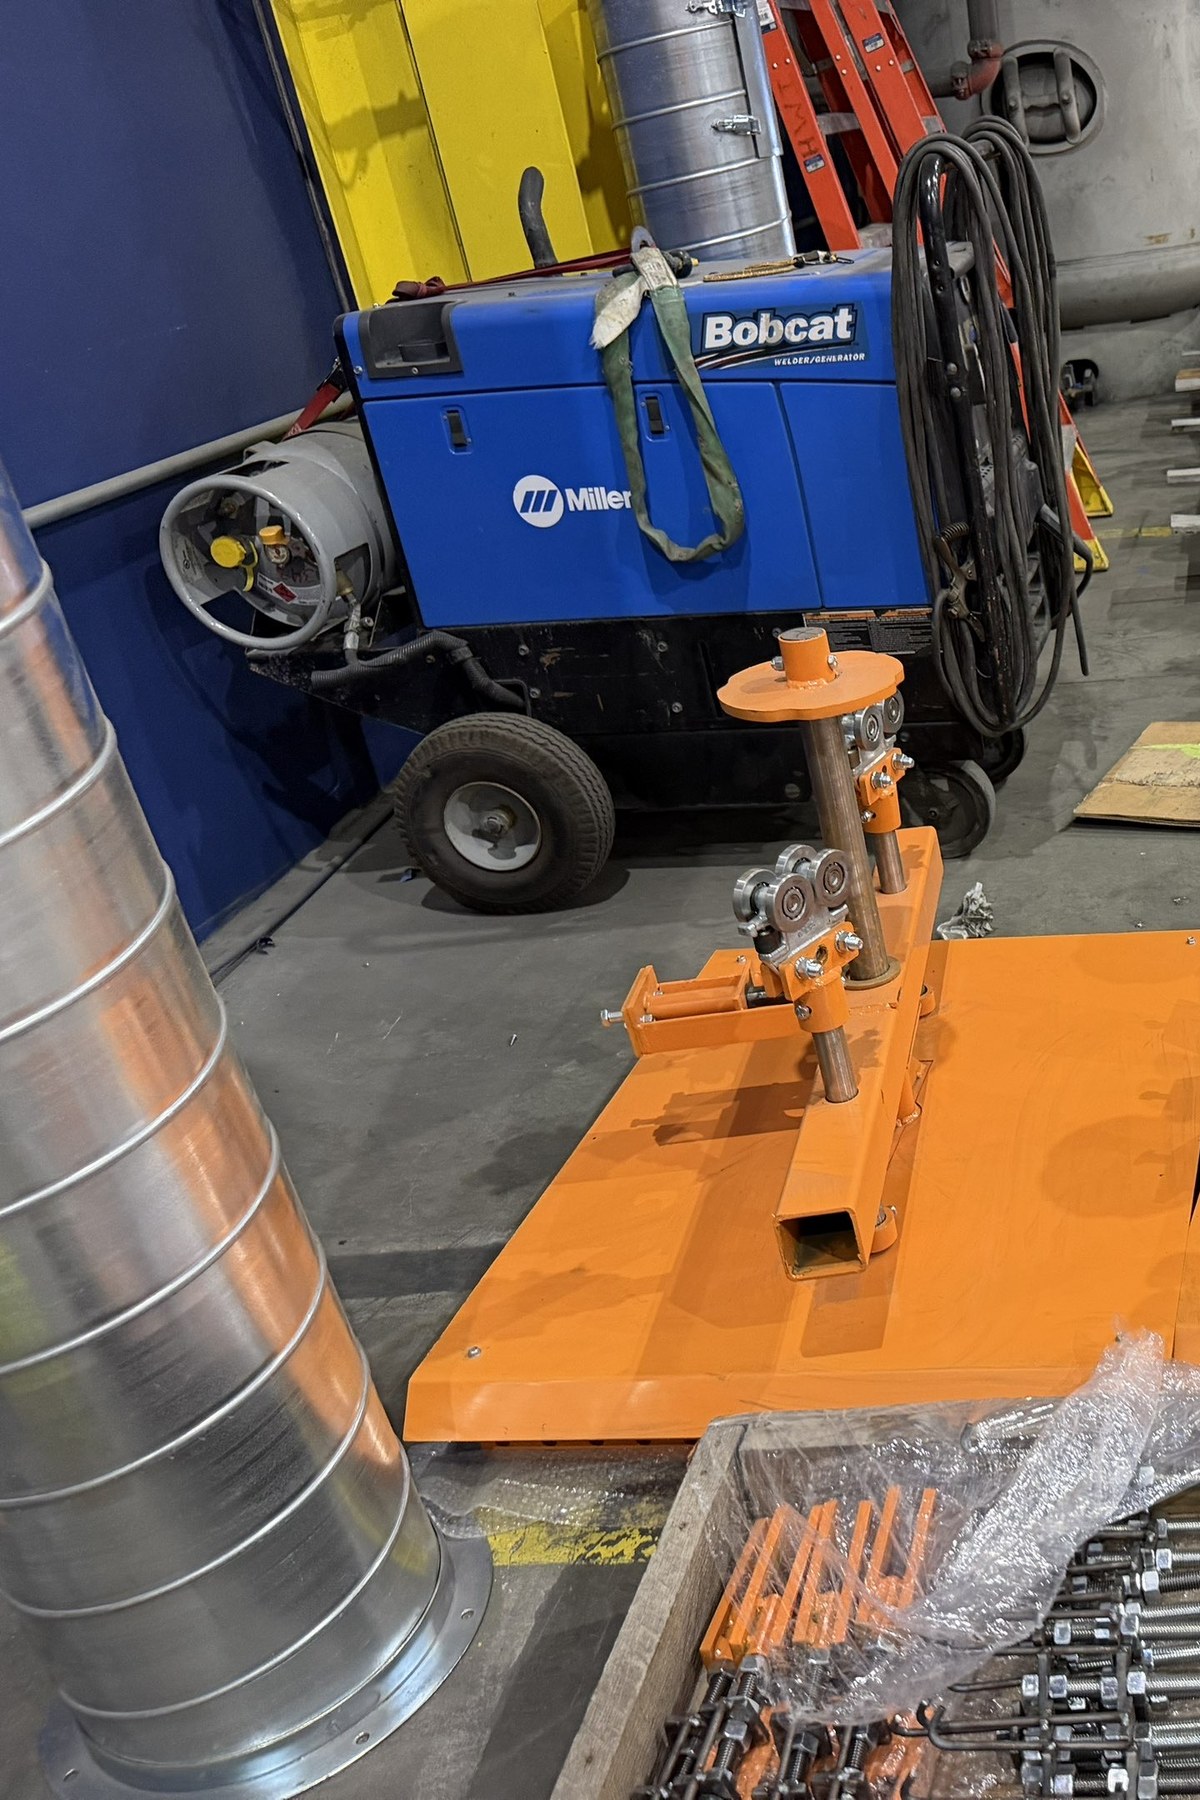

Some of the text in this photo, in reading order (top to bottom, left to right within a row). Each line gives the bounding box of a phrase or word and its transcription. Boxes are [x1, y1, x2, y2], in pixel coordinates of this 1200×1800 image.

[703, 306, 854, 349] Bobcat
[774, 352, 866, 366] WELDER/GENERATOR
[565, 486, 632, 512] Miller
